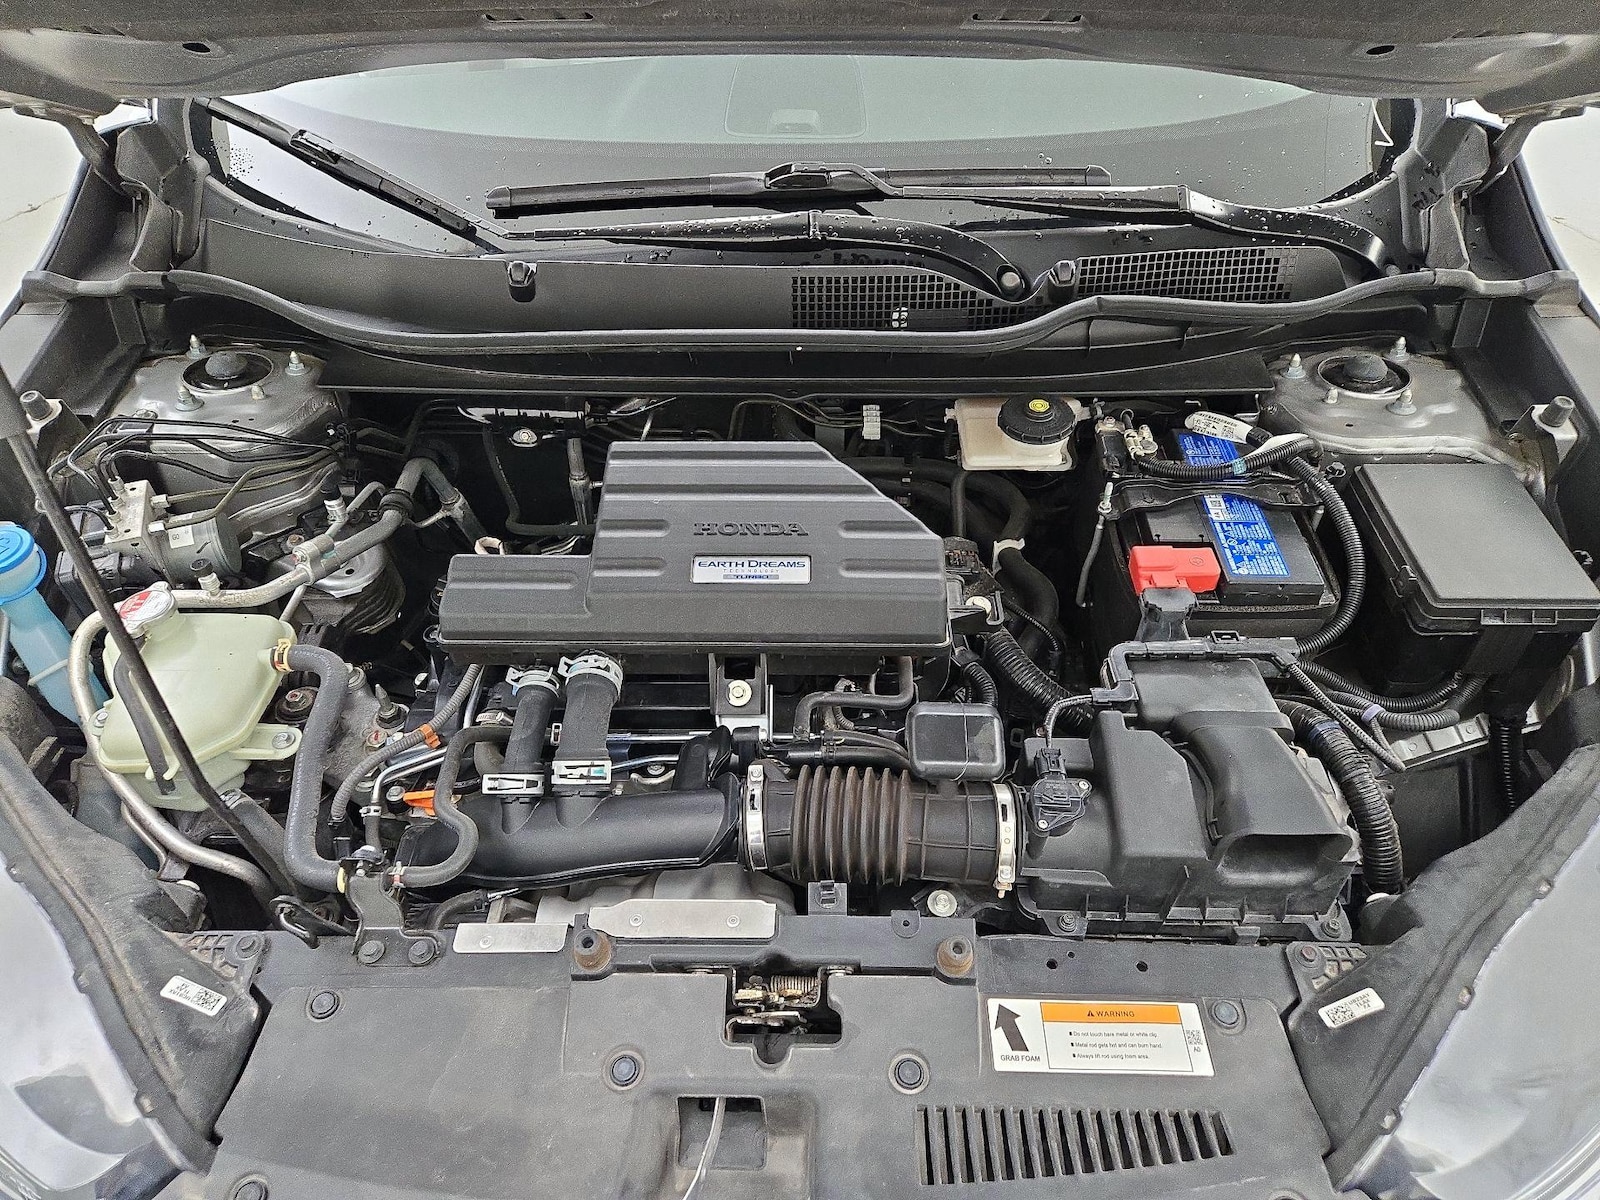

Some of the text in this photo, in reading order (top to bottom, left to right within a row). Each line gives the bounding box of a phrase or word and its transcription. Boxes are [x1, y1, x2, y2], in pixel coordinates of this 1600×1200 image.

[693, 522, 809, 536] HONDA
[747, 560, 806, 568] DREAMS
[1096, 1010, 1135, 1018] WARNING
[1077, 1052, 1094, 1060] Always
